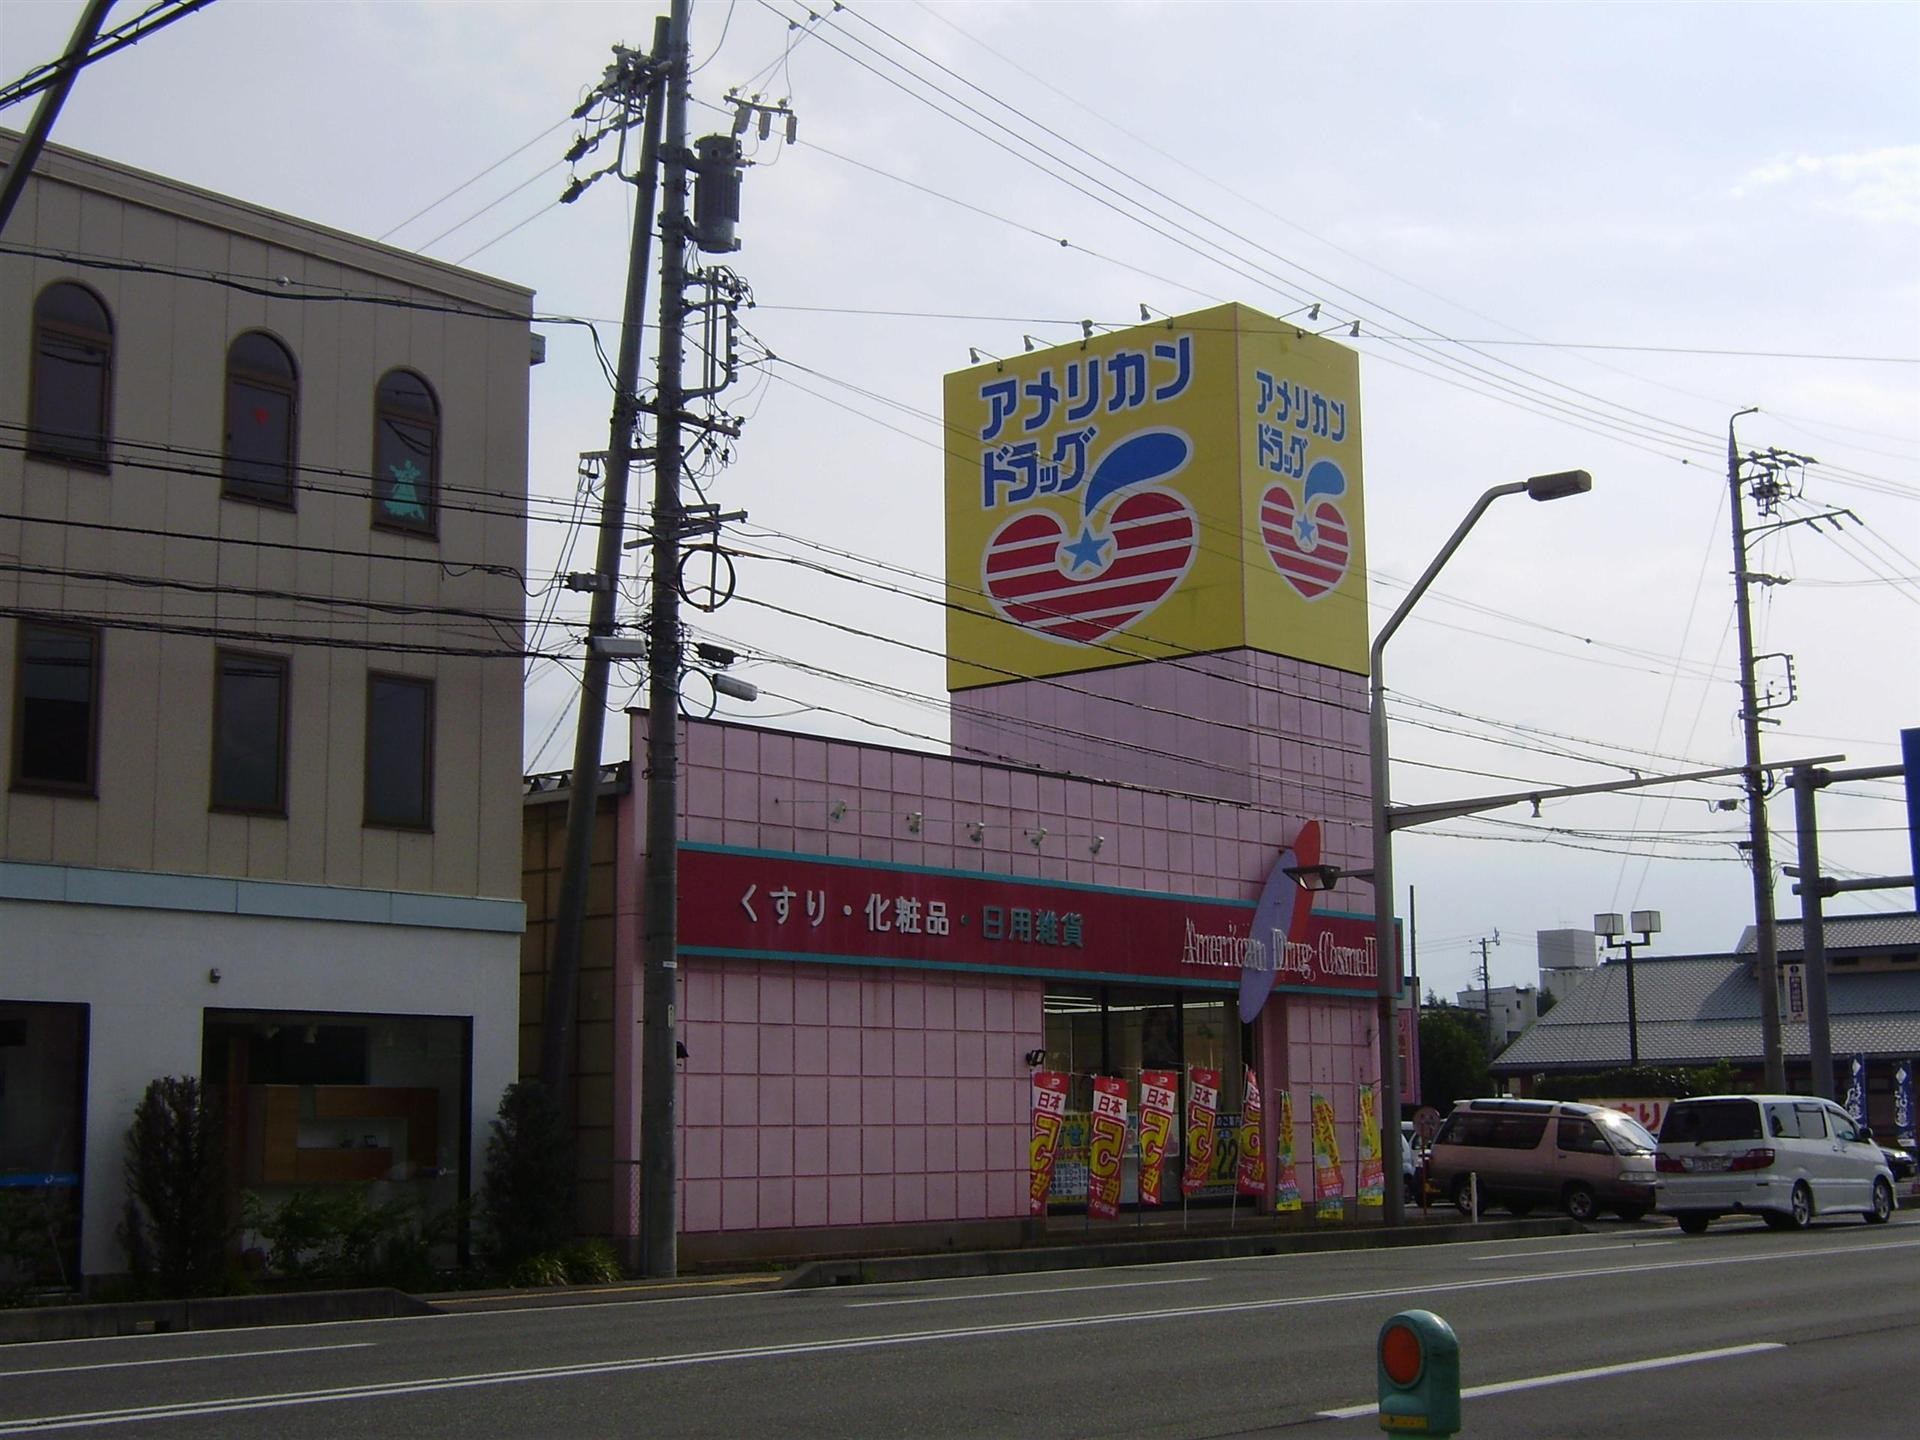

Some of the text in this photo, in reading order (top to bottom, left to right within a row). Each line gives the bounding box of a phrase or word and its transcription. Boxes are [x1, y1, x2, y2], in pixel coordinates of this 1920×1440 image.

[981, 336, 1191, 440] アメリカン
[1255, 369, 1346, 442] アメリカン
[983, 426, 1097, 508] ドラッグ
[1258, 425, 1308, 480] ドラッグ
[1181, 917, 1268, 972] American
[1272, 927, 1317, 982] Drug
